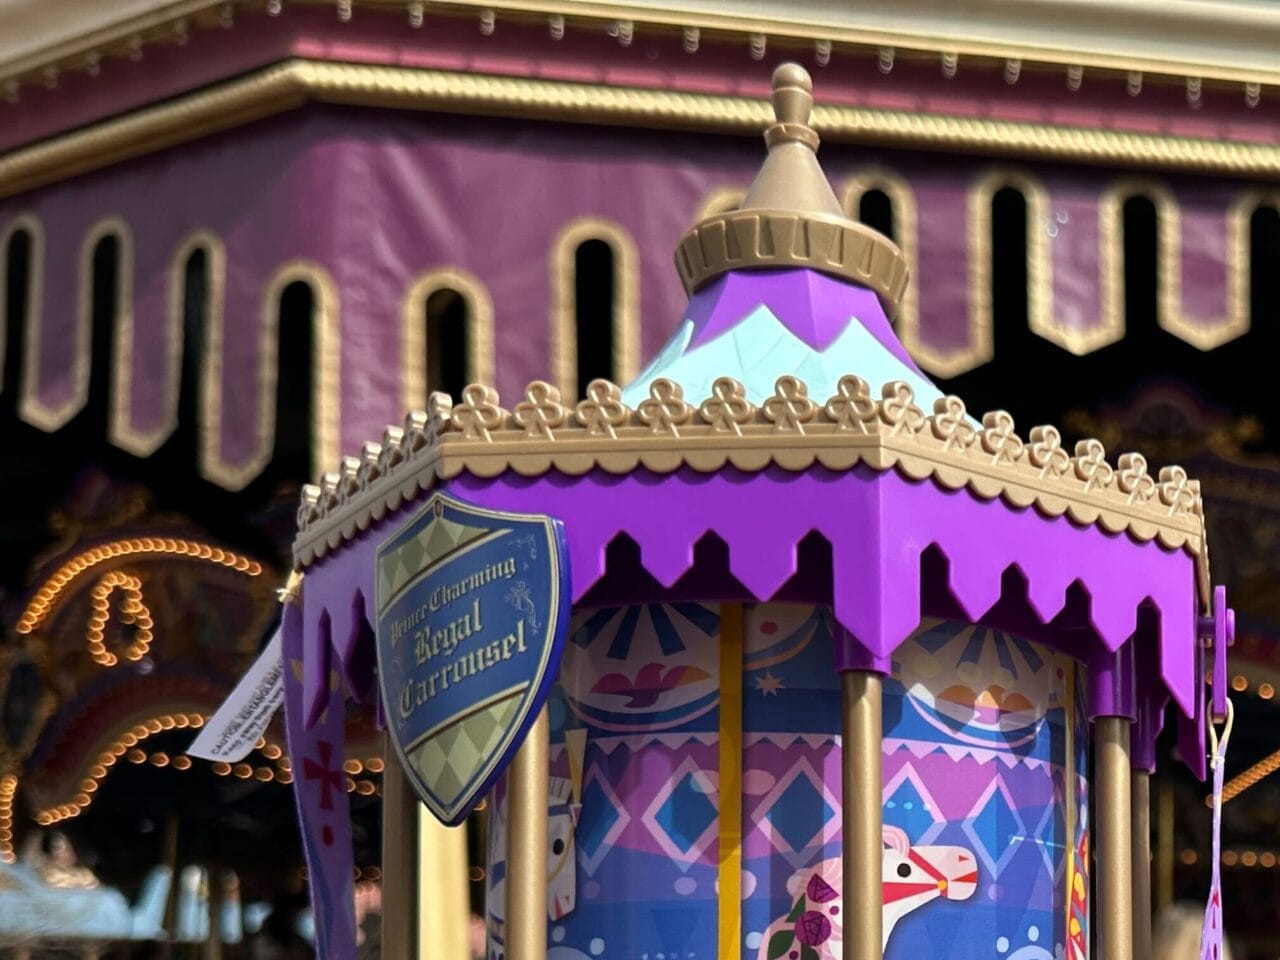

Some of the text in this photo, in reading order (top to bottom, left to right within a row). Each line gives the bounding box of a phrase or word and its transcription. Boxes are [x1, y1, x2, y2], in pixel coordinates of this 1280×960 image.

[391, 557, 516, 648] Prince Charming
[415, 598, 483, 668] Regal
[400, 618, 528, 719] Carrousel
